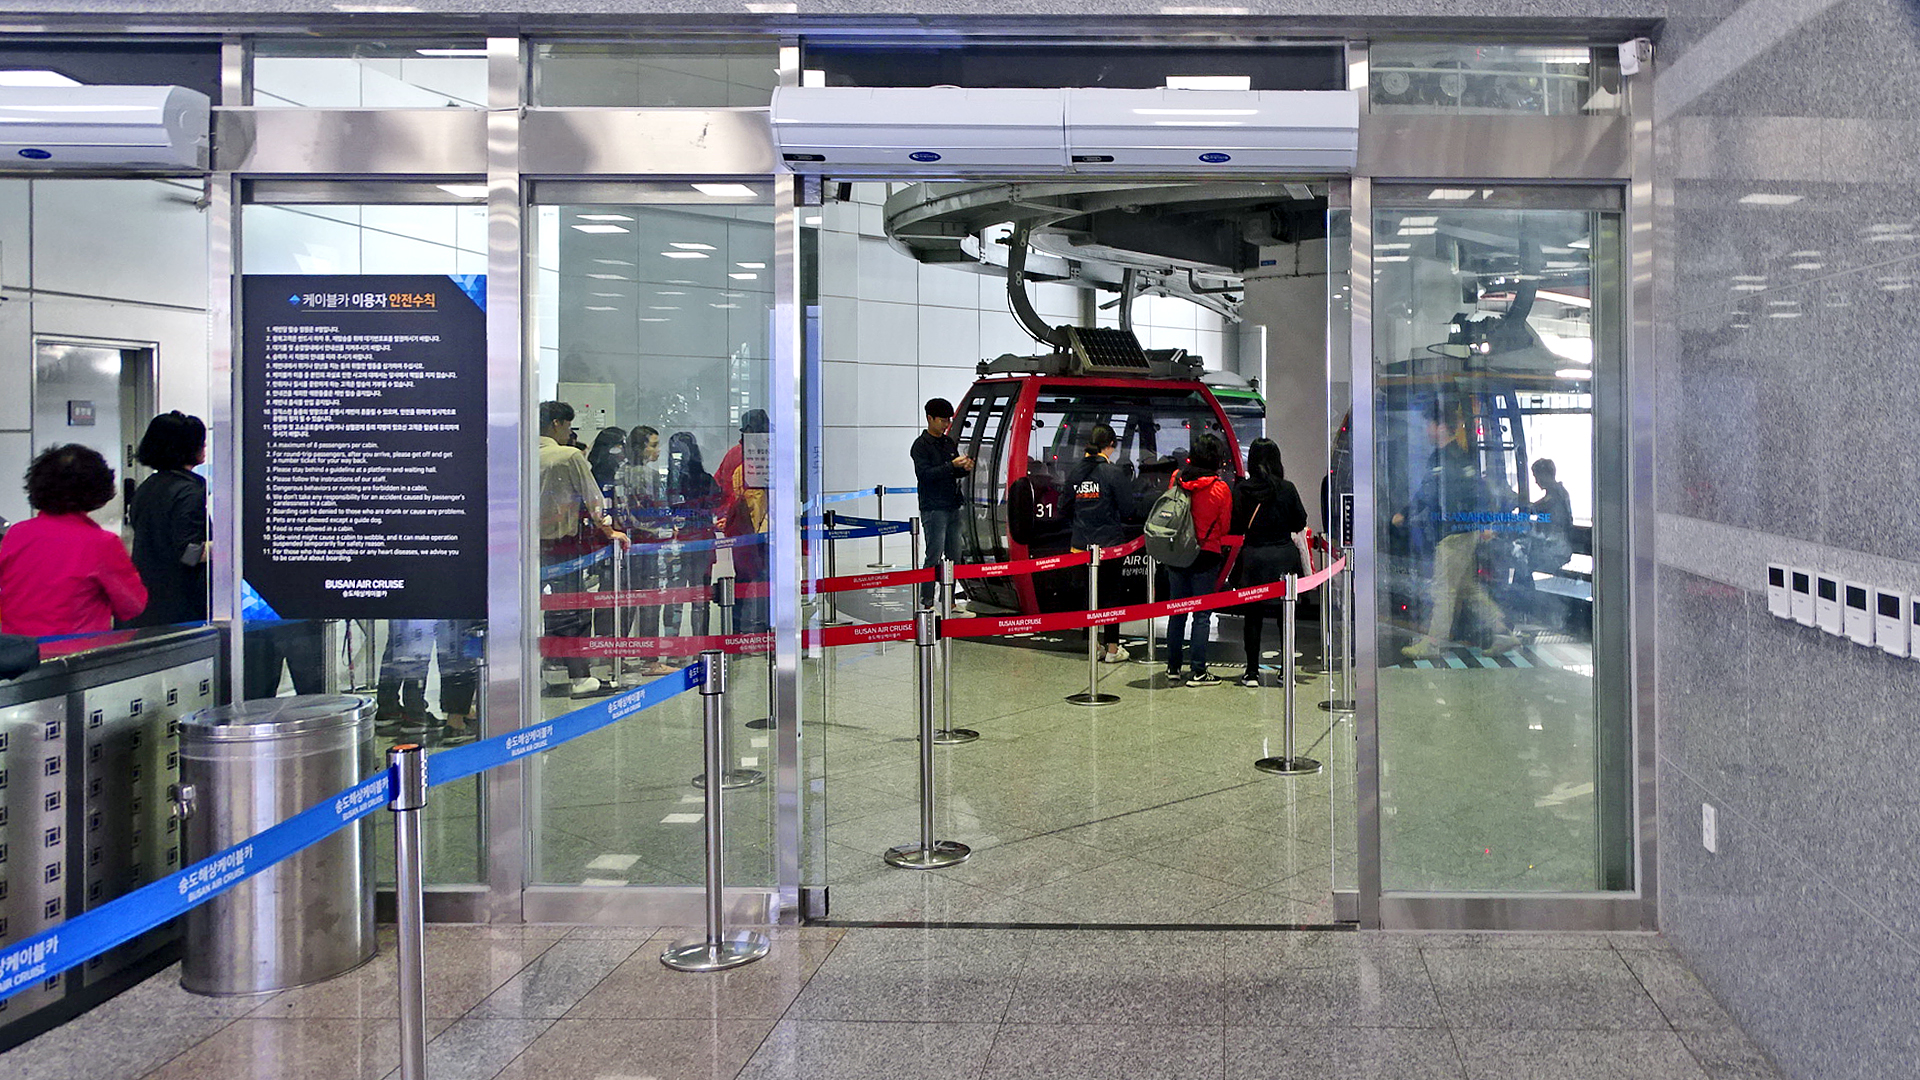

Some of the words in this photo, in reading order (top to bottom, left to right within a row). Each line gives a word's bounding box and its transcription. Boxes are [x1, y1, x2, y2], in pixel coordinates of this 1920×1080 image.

[303, 293, 350, 308] 케이블카
[352, 293, 387, 308] 이용자
[389, 293, 436, 308] 안전수칙
[1035, 503, 1053, 518] 31
[1123, 555, 1141, 566] AIR
[325, 579, 355, 589] BUSAN
[356, 579, 372, 589] AIR
[372, 579, 404, 589] CRUISE
[1024, 617, 1042, 625] CRUISE
[854, 627, 877, 635] BUSAN
[889, 624, 913, 632] CRUISE
[589, 641, 615, 649] BUSAN
[628, 640, 655, 648] CRUISE
[725, 638, 749, 646] BUSAN
[505, 724, 553, 750] 송도해상케이블카
[335, 776, 389, 814] 송도해상케이블카
[178, 843, 254, 895] 송도해상케이블카
[187, 884, 211, 903] BUSAN
[211, 877, 223, 890] AIR
[223, 865, 246, 885] CRUISE
[14, 962, 47, 986] CRUISE
